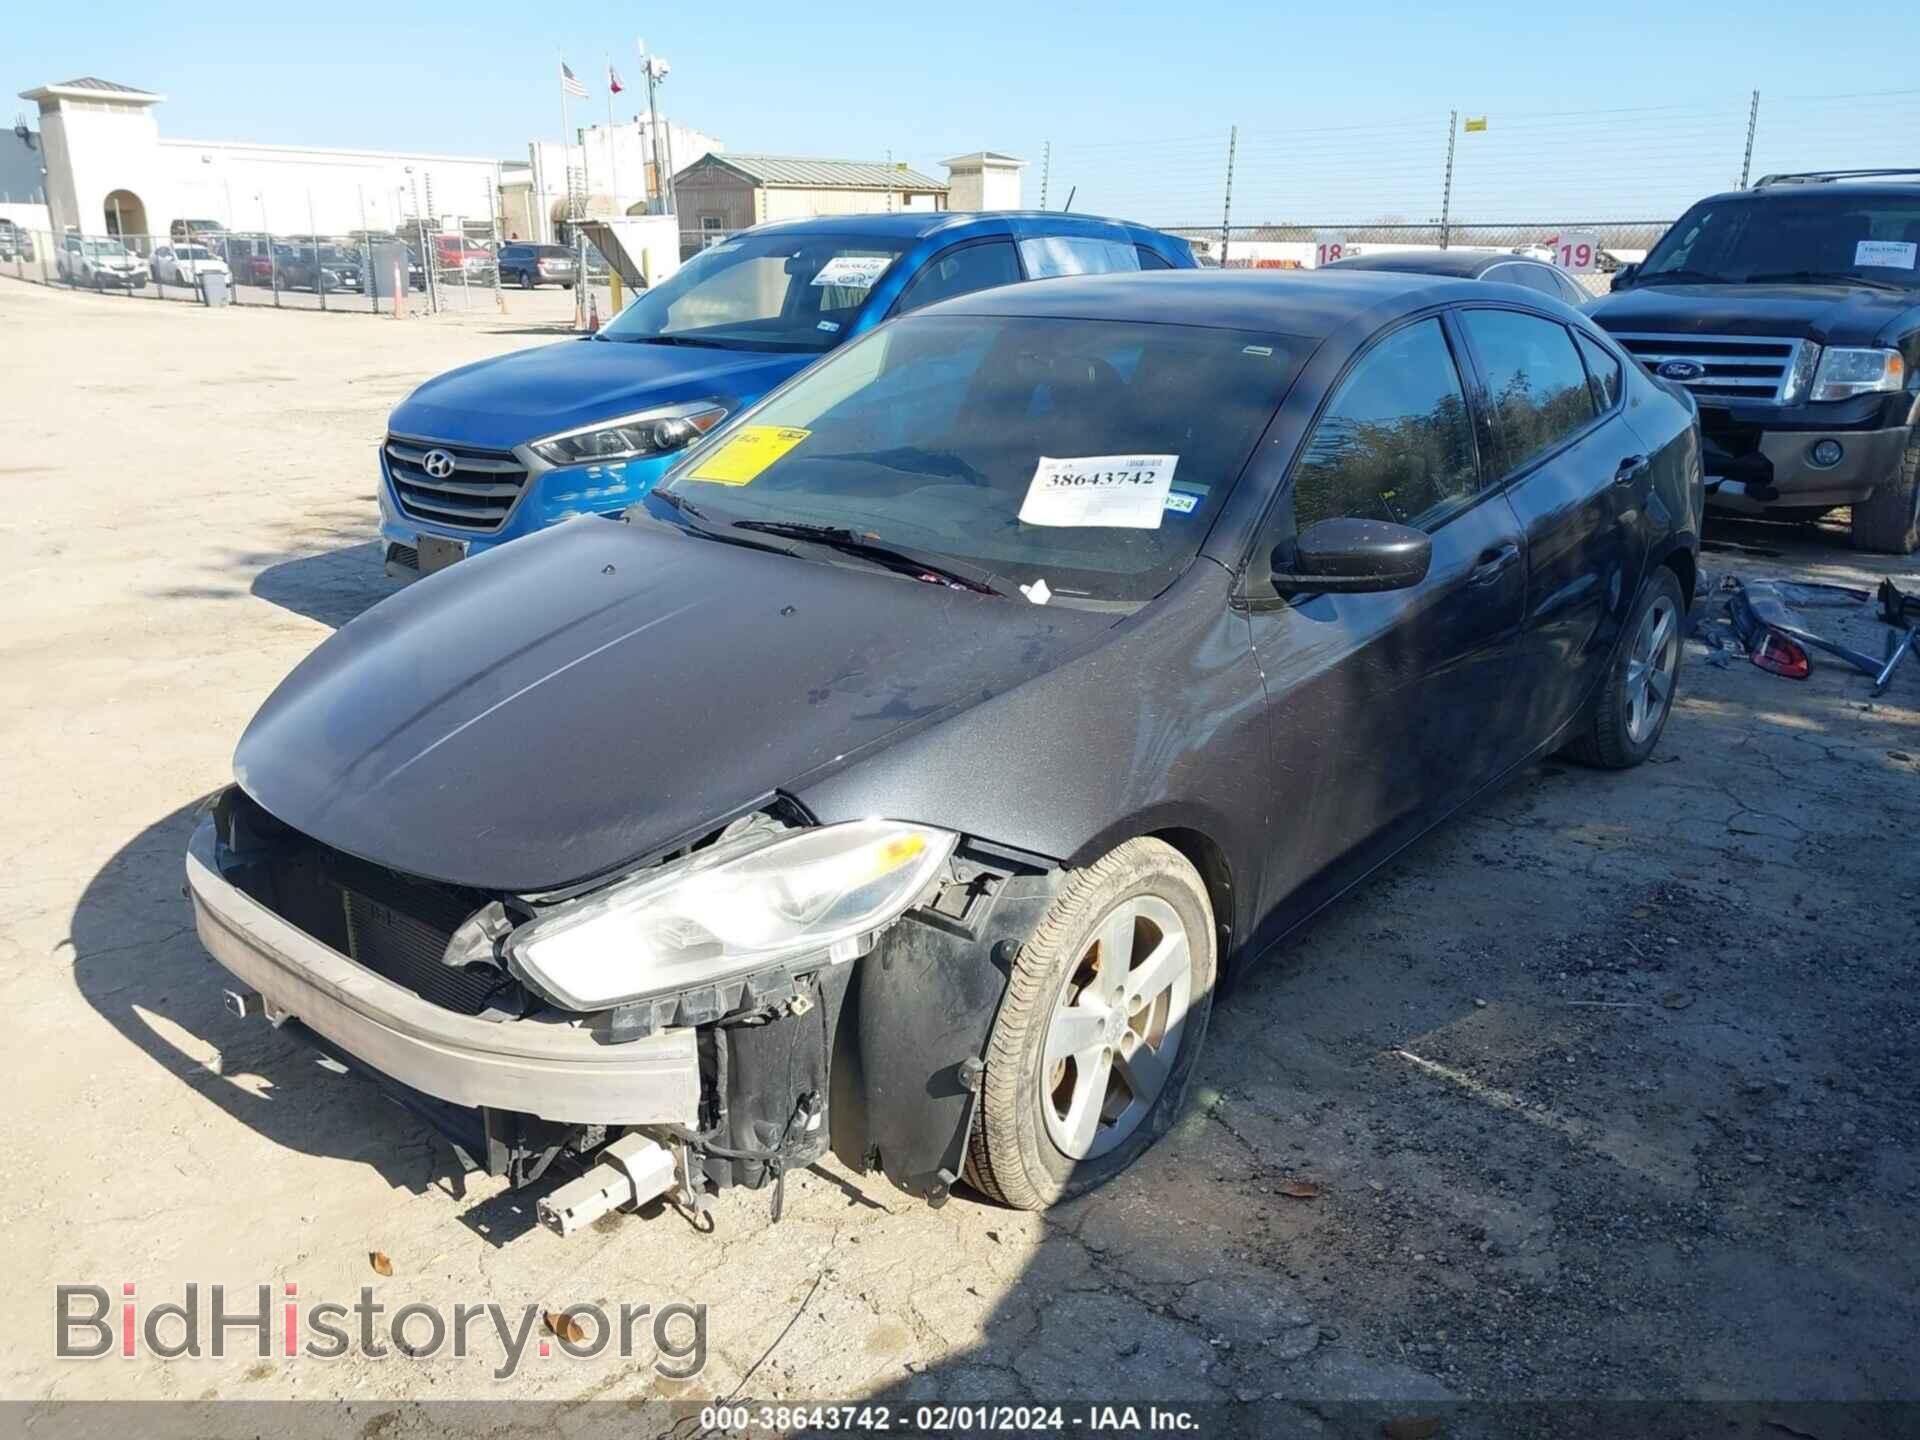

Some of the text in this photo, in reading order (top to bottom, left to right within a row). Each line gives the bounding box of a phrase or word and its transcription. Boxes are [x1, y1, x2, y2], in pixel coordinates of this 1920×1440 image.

[1318, 243, 1342, 265] 18
[1561, 244, 1591, 267] 19
[1045, 471, 1156, 487] 38643742
